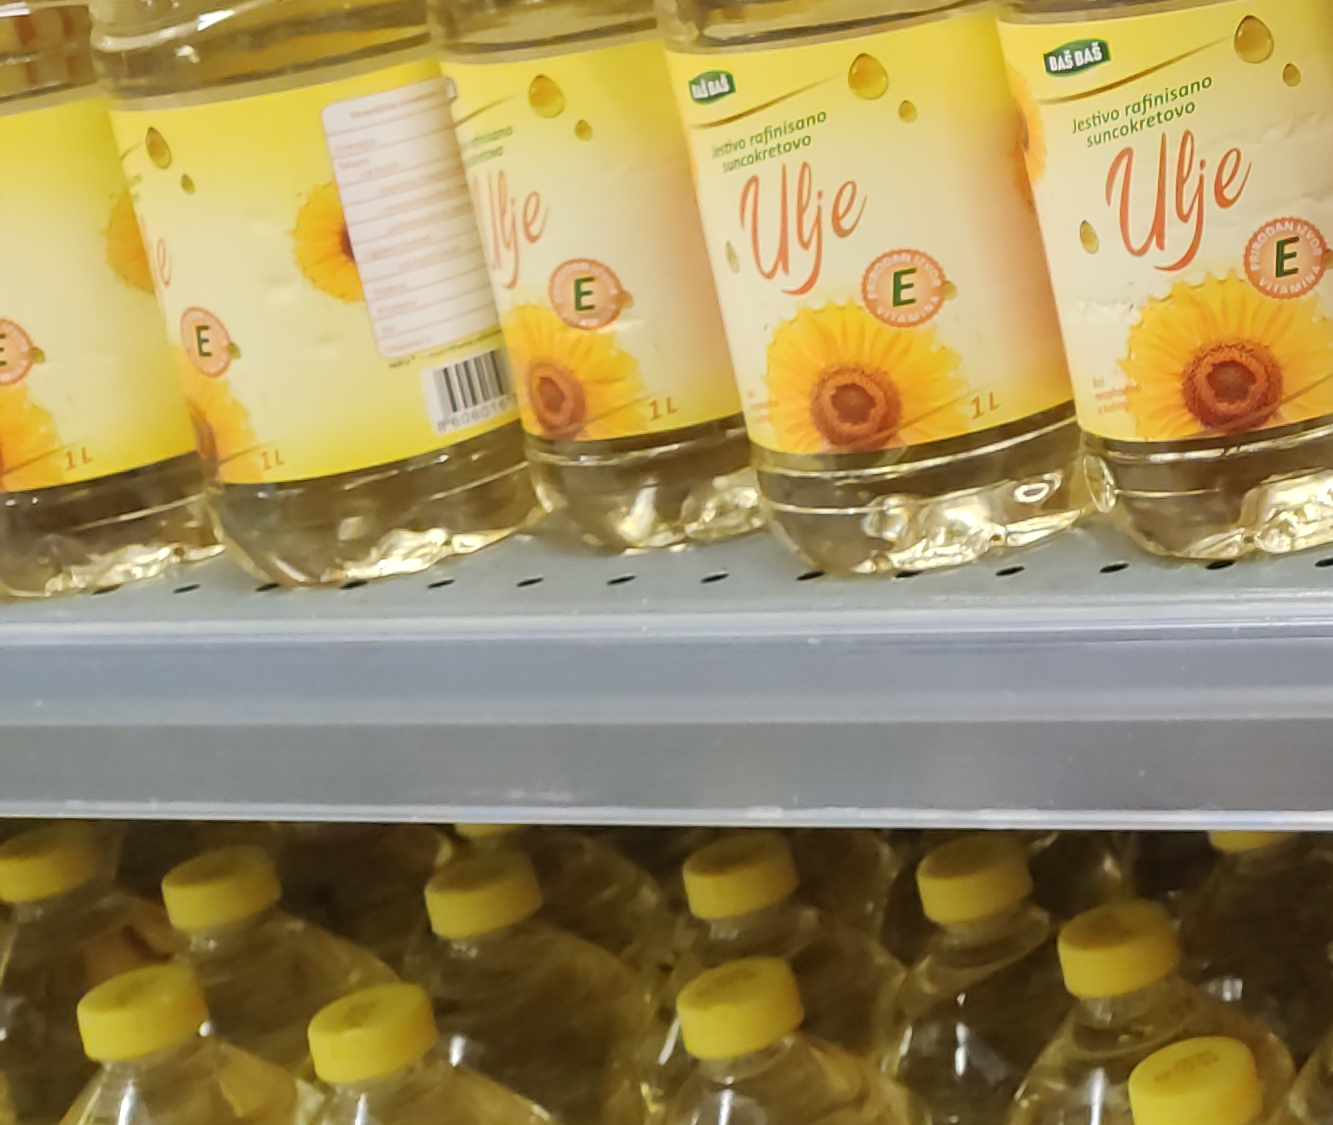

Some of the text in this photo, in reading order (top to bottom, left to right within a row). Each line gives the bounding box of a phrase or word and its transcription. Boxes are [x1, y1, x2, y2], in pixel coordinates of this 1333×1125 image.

[1048, 42, 1103, 72] BAŠ BAŠ
[1072, 76, 1213, 134] Jestivo rafinisano
[1087, 101, 1196, 148] suncokretovo
[749, 111, 827, 147] rafinisano
[722, 134, 812, 174] suncokretovo
[1105, 129, 1252, 272] Ulje
[739, 161, 868, 296] Ulje
[1275, 236, 1299, 278] E
[574, 276, 595, 311] E
[893, 267, 918, 308] E
[1260, 265, 1321, 295] VITAMINA
[195, 325, 212, 358] E
